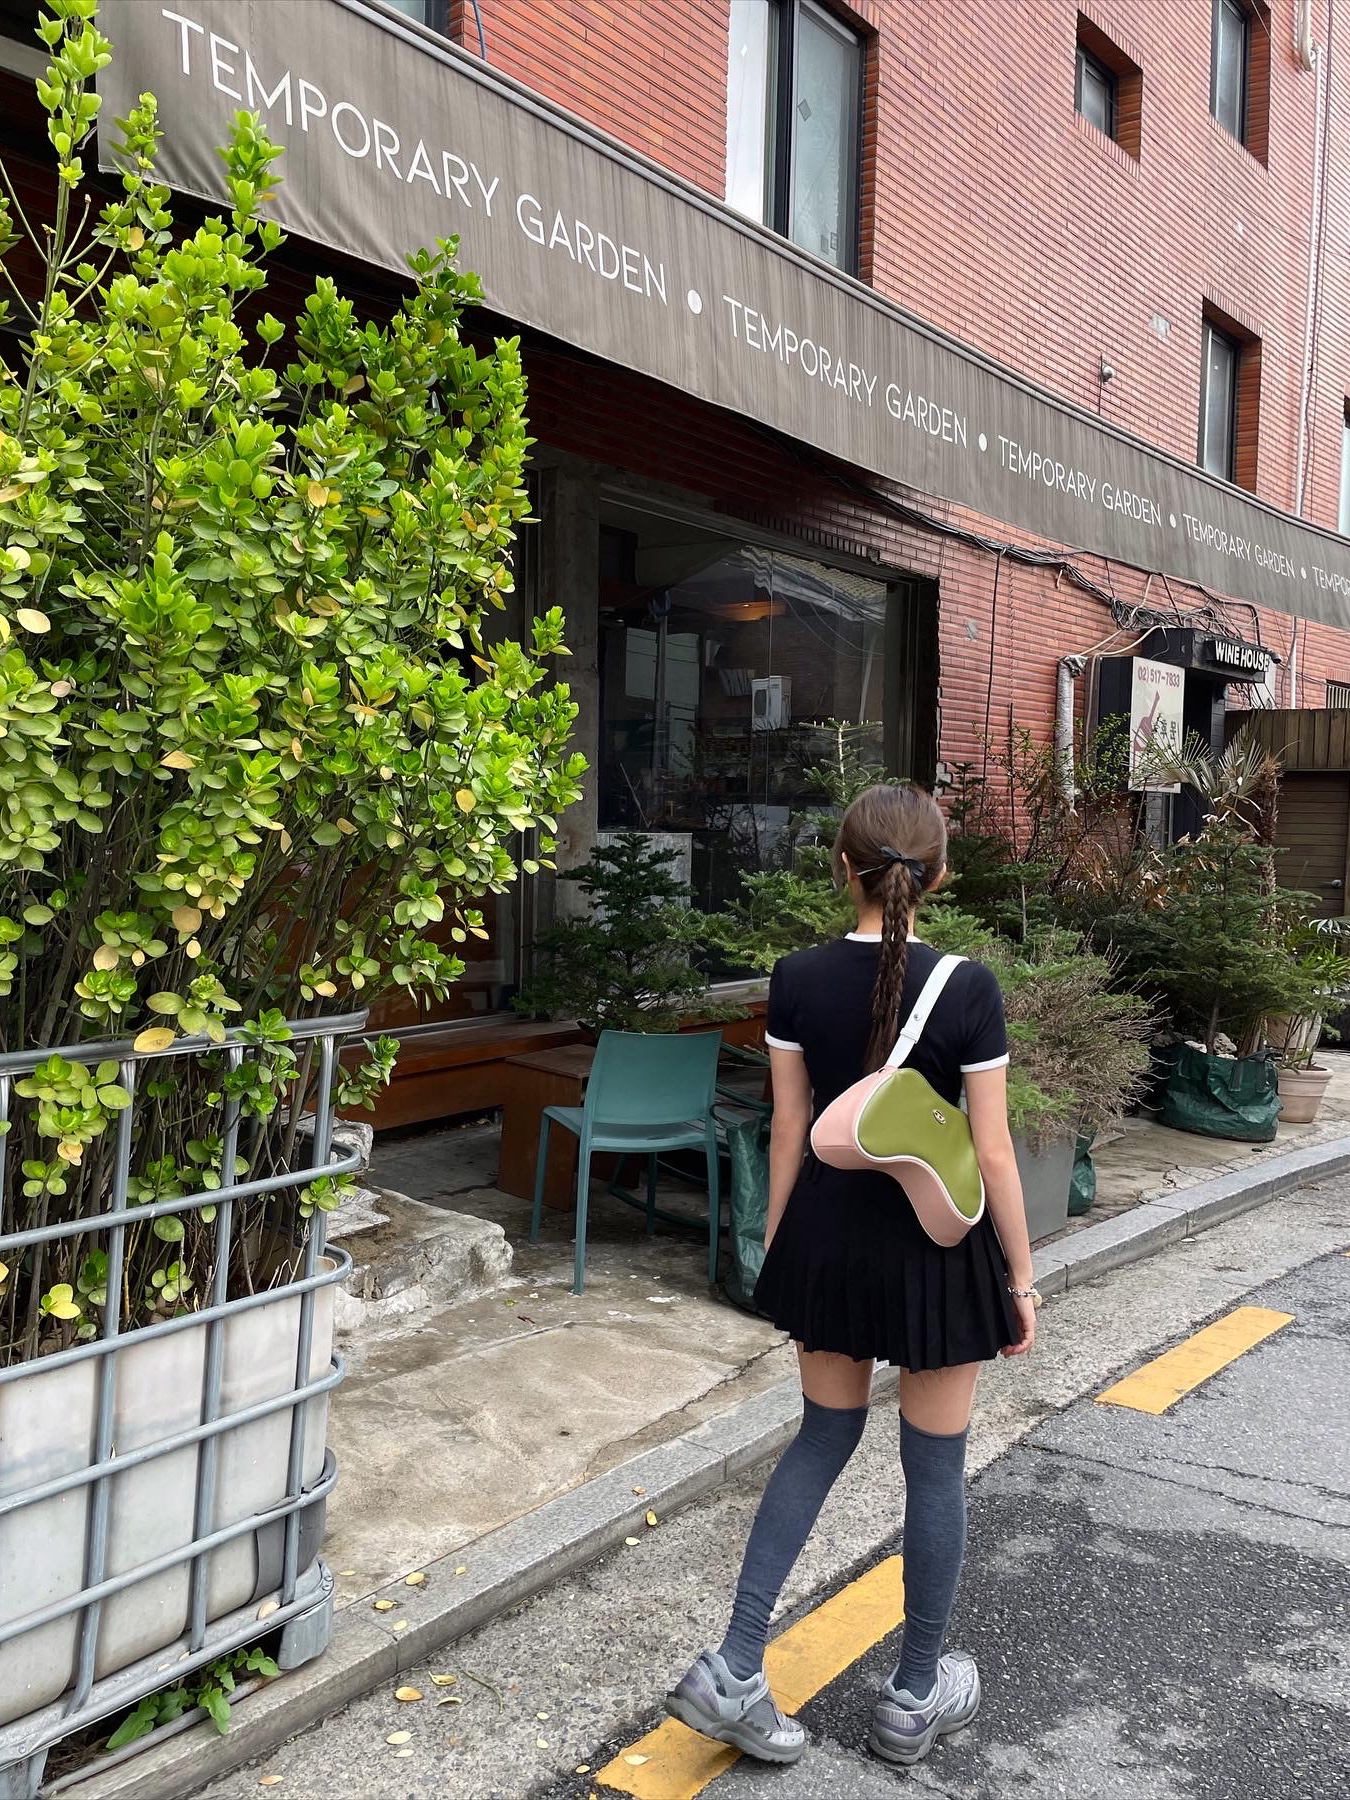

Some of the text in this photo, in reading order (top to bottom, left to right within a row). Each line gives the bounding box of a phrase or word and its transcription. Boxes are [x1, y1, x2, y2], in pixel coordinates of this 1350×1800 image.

[162, 8, 500, 218] TEMPORARY
[516, 193, 667, 306] GARDEN
[723, 294, 877, 407] TEMPORARY
[885, 383, 967, 449] GARDEN
[998, 434, 1096, 503] TEMPORARY
[1101, 483, 1162, 527] GARDEN
[1183, 513, 1251, 561] TEMPORARY
[1254, 544, 1296, 578] GARDEN
[1215, 640, 1270, 672] WINE HOUSE
